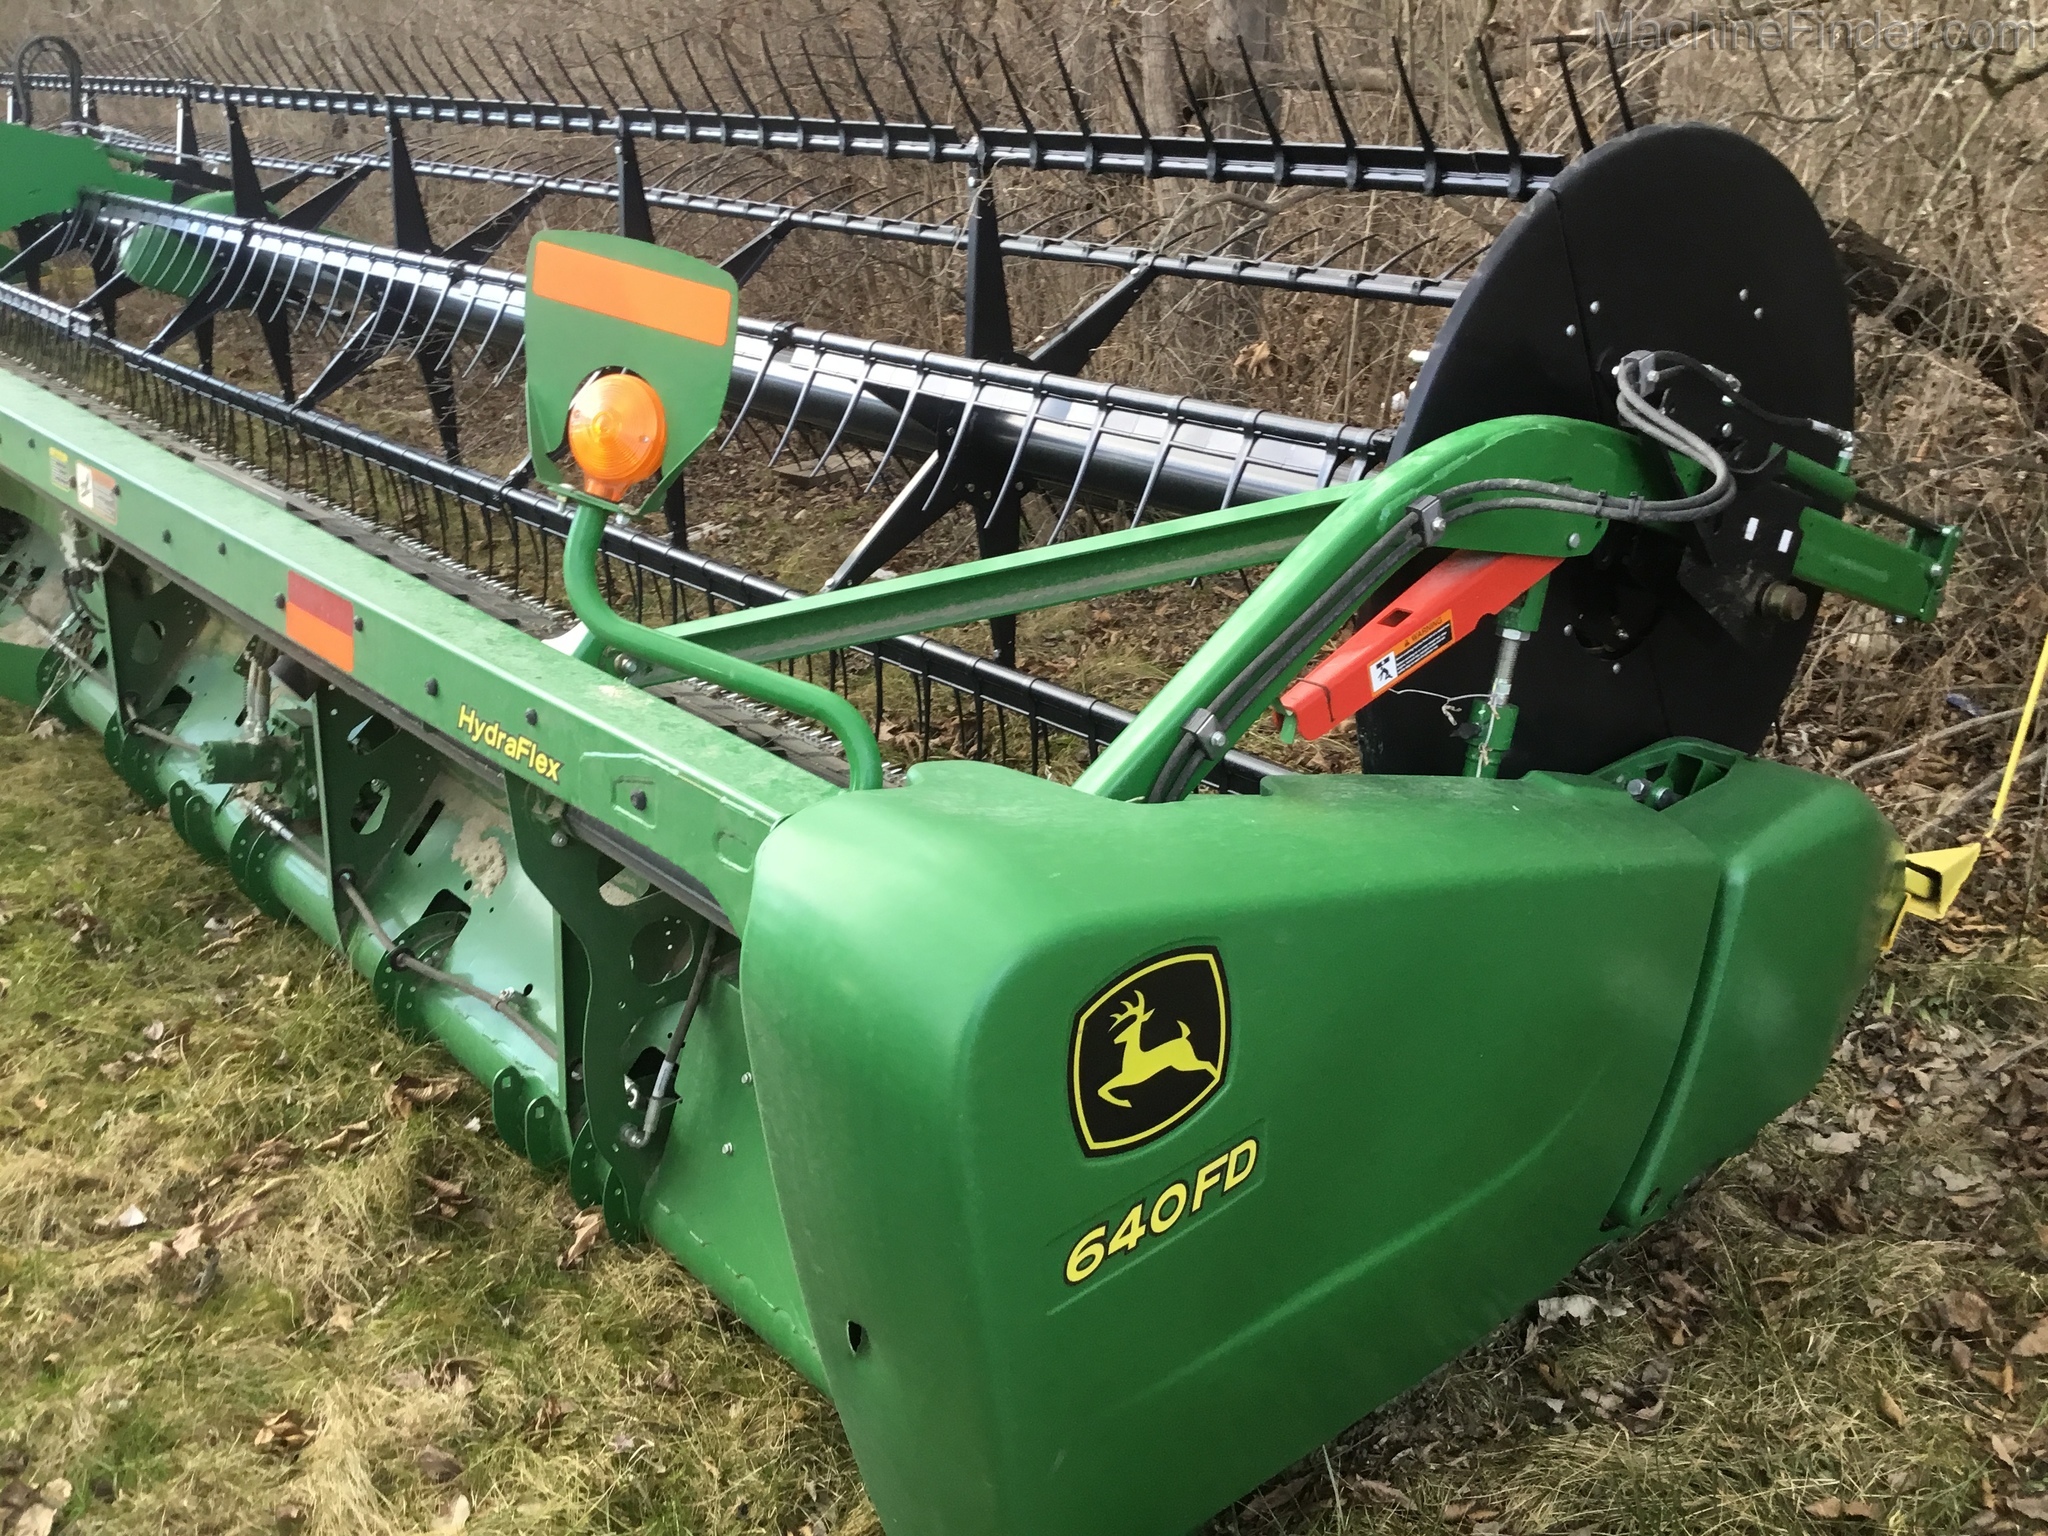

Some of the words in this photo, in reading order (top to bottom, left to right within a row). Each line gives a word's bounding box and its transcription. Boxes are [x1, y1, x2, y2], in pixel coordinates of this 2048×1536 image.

[1411, 617, 1443, 641] WARNING
[458, 703, 562, 783] HydraFlex
[1065, 1137, 1259, 1285] 640FD
